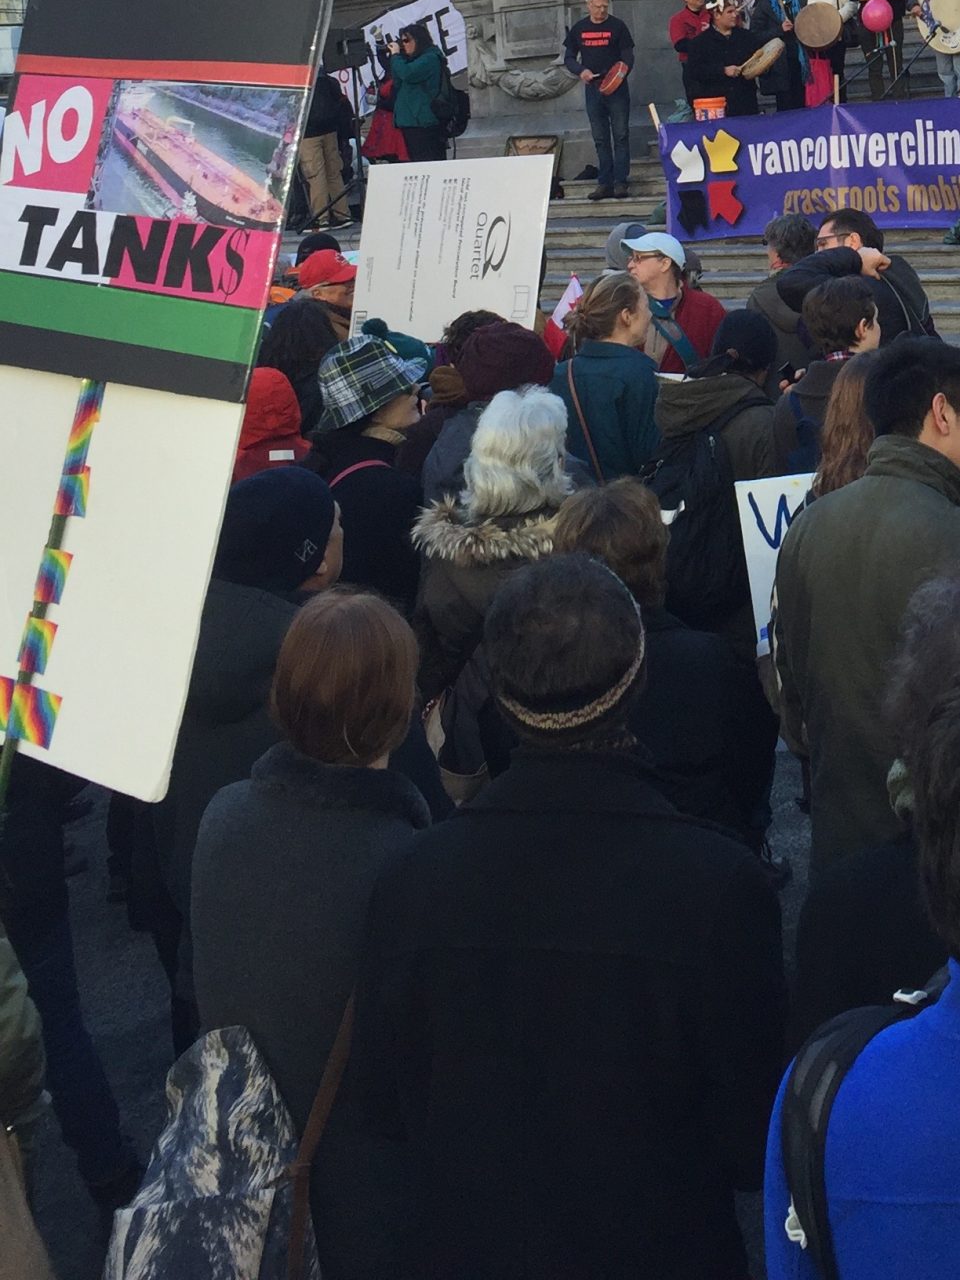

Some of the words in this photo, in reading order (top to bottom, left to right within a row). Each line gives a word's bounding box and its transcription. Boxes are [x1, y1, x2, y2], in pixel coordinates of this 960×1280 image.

[1, 84, 94, 186] NO
[783, 176, 900, 216] grassroots
[469, 210, 488, 281] Quartet
